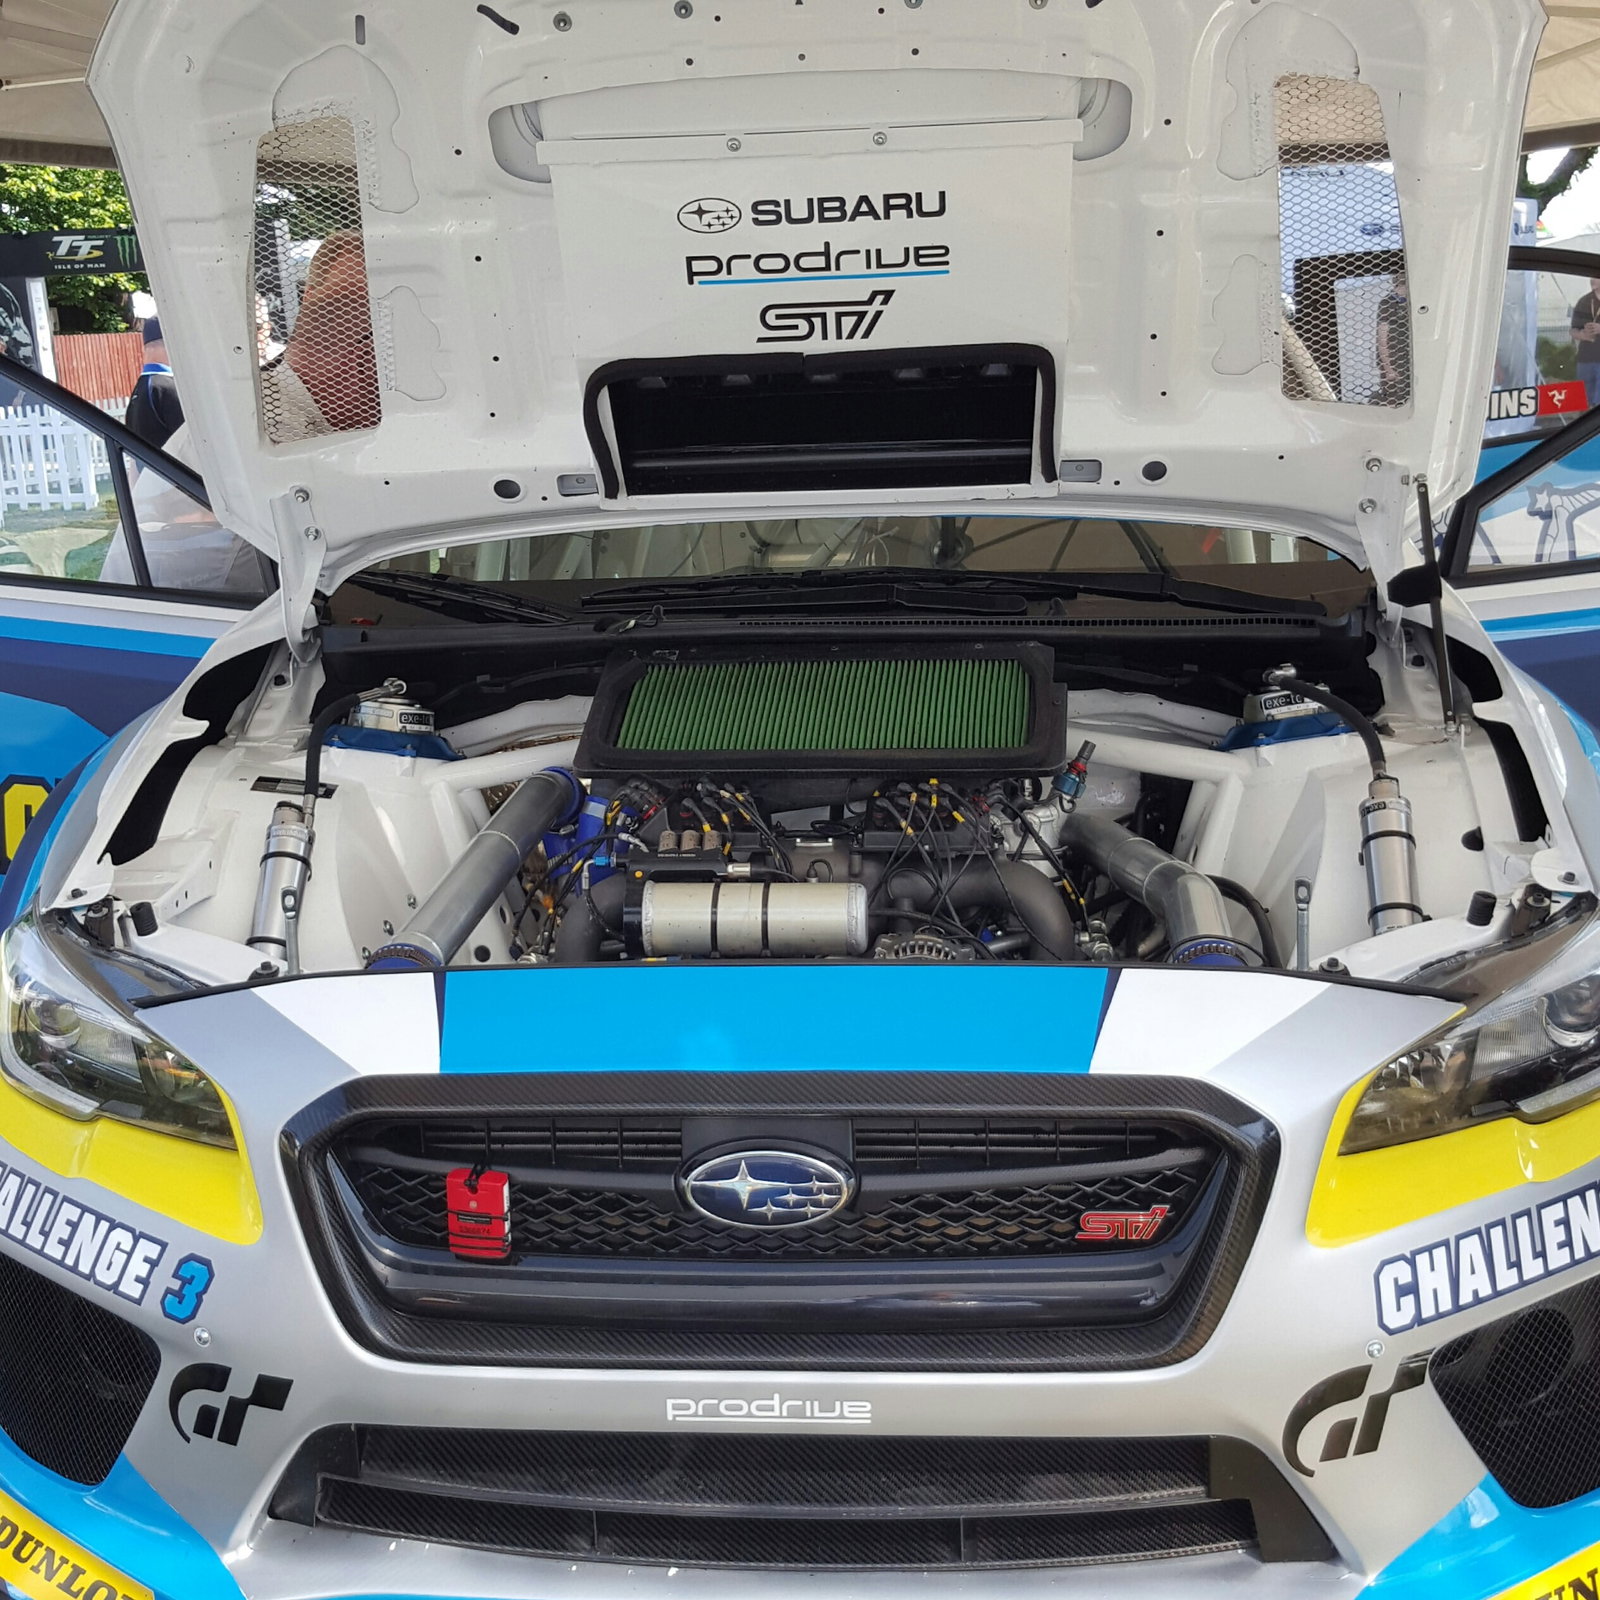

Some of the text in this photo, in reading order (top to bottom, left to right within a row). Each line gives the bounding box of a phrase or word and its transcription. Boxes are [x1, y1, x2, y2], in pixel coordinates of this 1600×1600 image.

[751, 190, 946, 227] SUBARU
[51, 235, 104, 257] TT
[685, 241, 950, 285] prodrive
[1488, 386, 1538, 420] INS
[0, 1159, 215, 1324] ALLENGE 3
[1373, 1178, 1600, 1336] CHALLEN
[666, 1393, 872, 1421] prodrive
[0, 1515, 134, 1600] DUNLO
